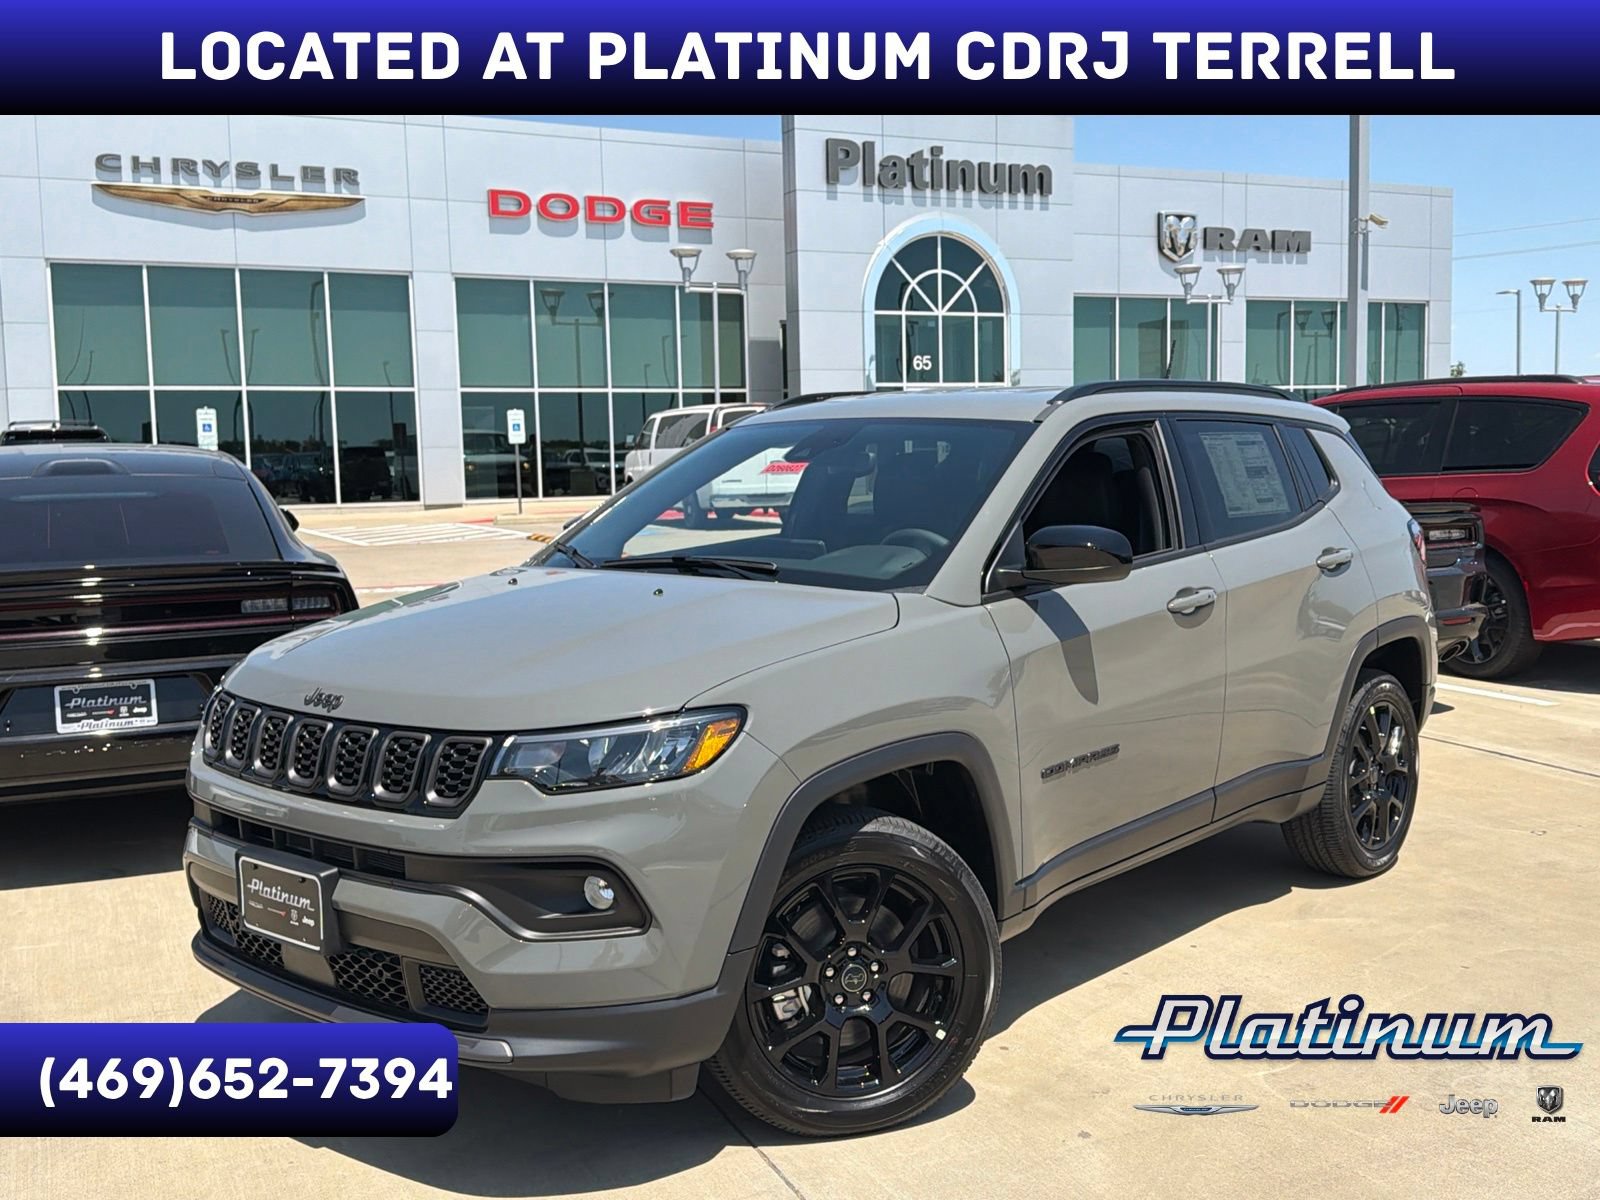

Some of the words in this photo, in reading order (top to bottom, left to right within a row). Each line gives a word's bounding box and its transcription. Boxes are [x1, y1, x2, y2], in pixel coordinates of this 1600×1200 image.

[95, 153, 360, 186] CHRYSLER
[826, 138, 1053, 196] Platinum
[487, 188, 714, 229] DODGE
[1203, 226, 1312, 254] RAM
[913, 355, 932, 370] 65
[64, 695, 147, 709] Platinum
[247, 878, 315, 912] Platinum
